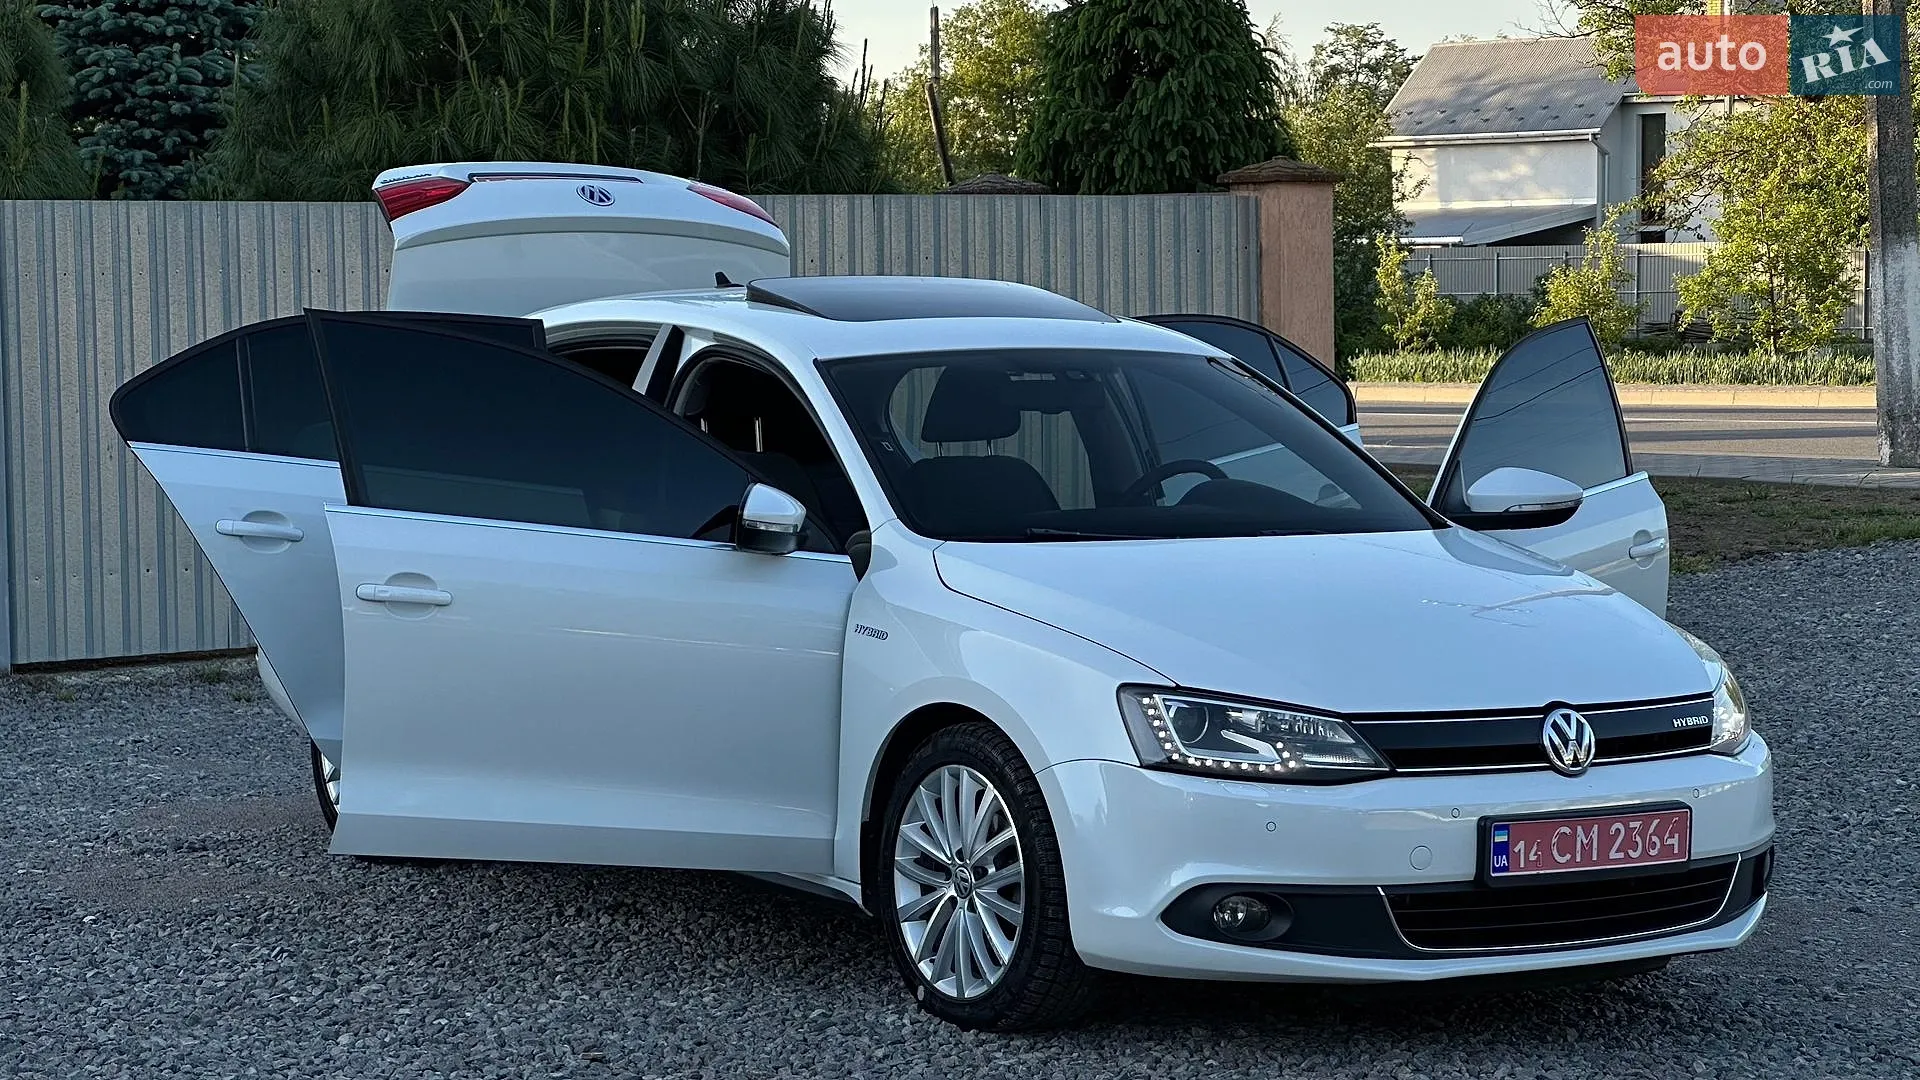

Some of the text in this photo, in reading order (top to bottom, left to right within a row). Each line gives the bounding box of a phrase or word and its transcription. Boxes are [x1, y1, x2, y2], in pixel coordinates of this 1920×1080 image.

[1672, 715, 1709, 728] HYBRID
[1513, 816, 1680, 868] 14 CM 2364
[1493, 855, 1508, 868] UA
